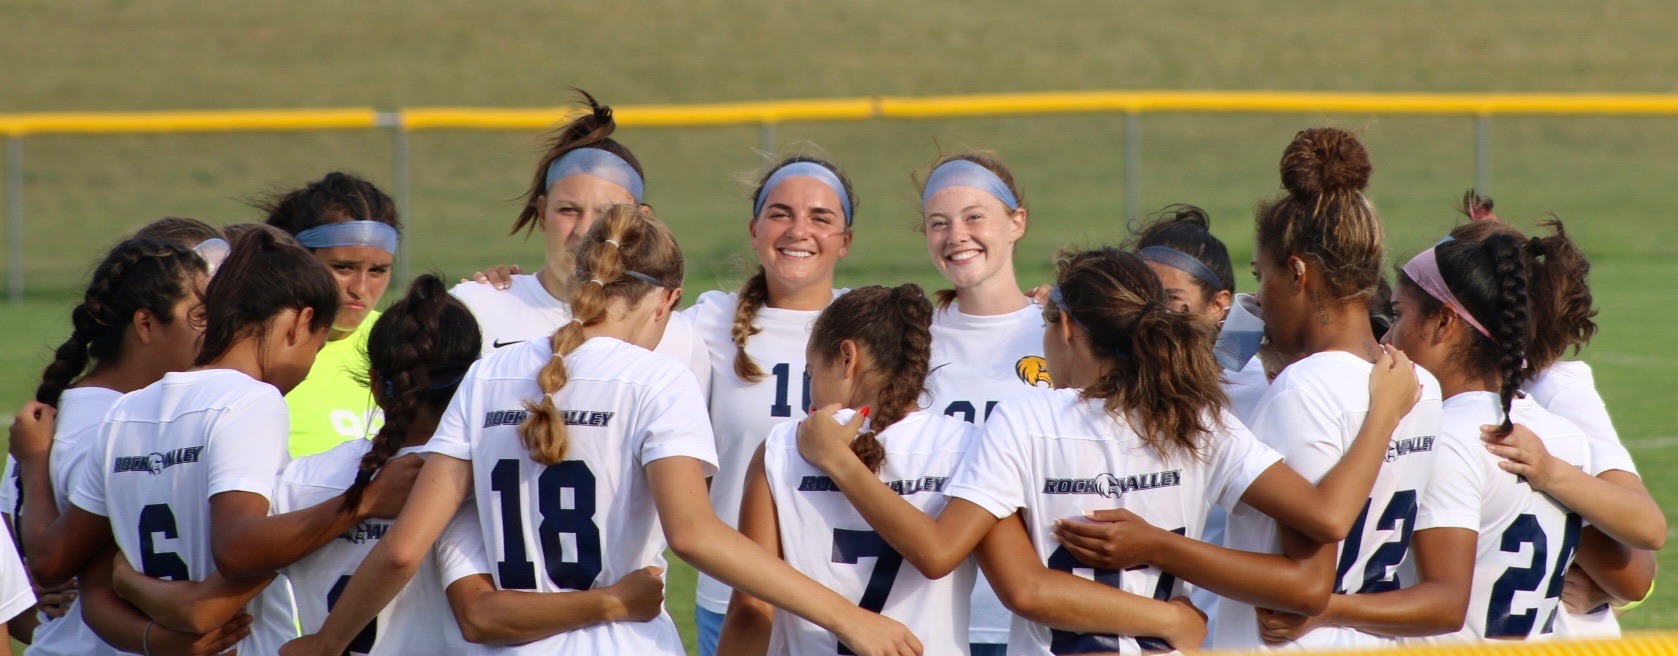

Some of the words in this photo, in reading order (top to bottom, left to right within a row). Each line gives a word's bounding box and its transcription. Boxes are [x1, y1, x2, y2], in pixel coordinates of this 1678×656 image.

[483, 410, 529, 428] ROCK
[559, 410, 615, 427] ALLEY
[113, 456, 151, 473] ROCK
[884, 476, 949, 496] ALLEY
[1042, 478, 1098, 494] ROCK
[1115, 469, 1182, 493] VALLEY
[138, 503, 190, 580] 6
[491, 459, 602, 590] 18
[1332, 489, 1418, 594] 12
[831, 527, 904, 655] 7
